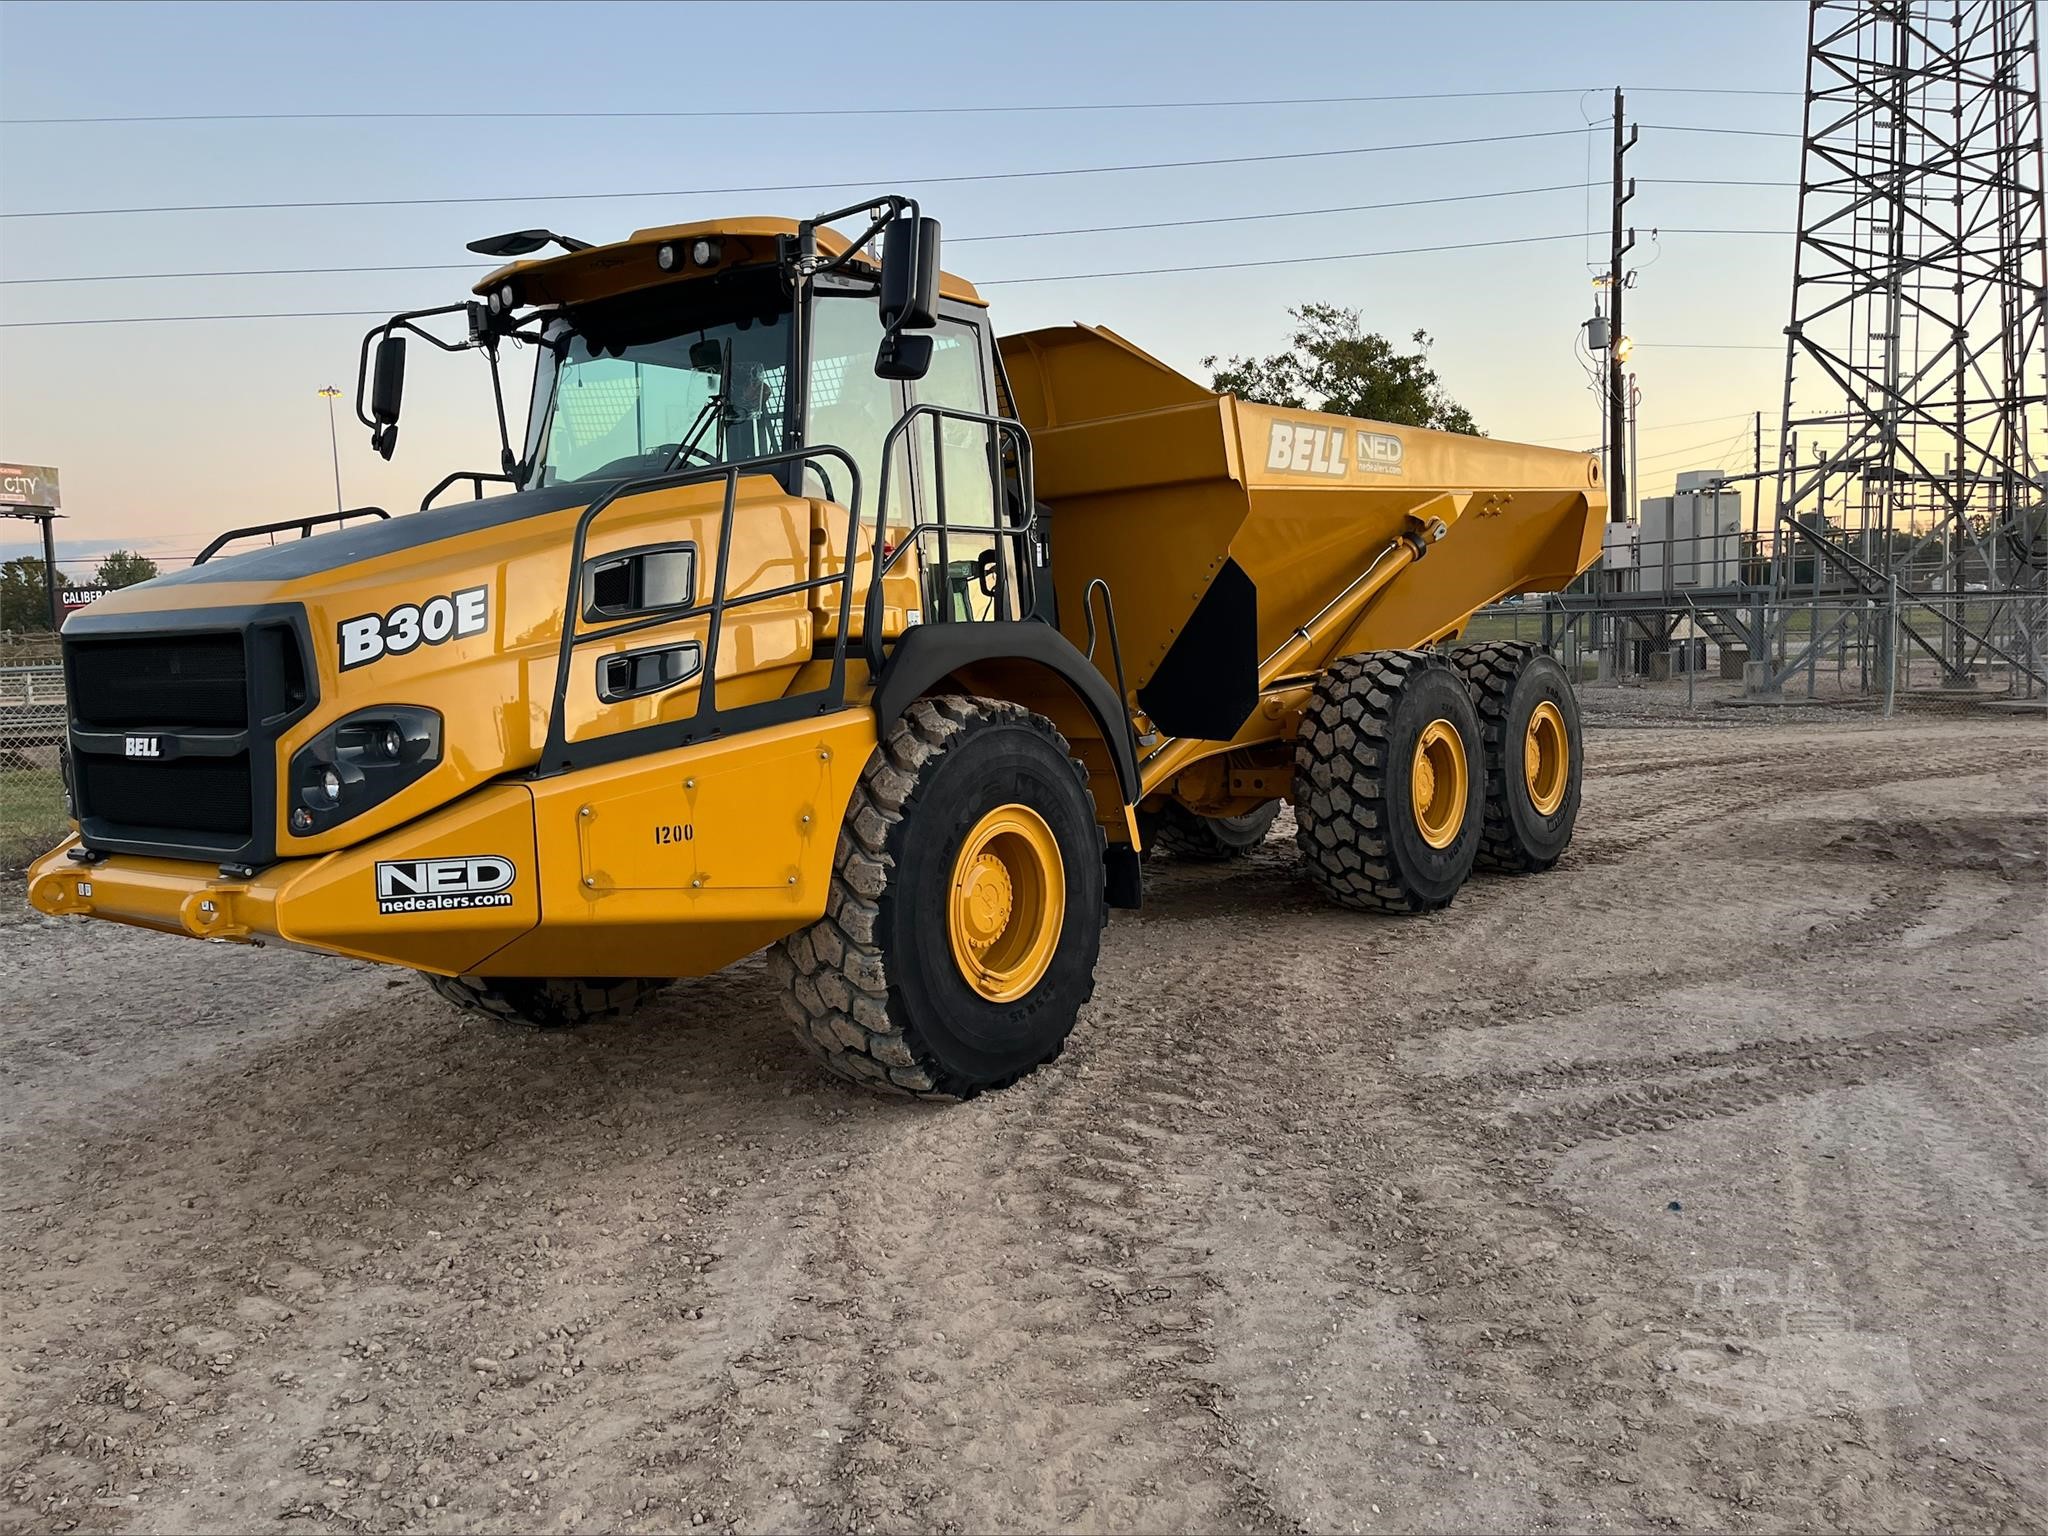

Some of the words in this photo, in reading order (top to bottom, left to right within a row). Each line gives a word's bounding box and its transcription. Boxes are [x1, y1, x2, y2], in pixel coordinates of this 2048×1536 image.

[1267, 423, 1346, 475] BELL
[1358, 433, 1402, 461] NED
[1358, 462, 1402, 475] nedealers.com
[4, 476, 40, 495] CITY
[341, 588, 486, 667] B30E
[126, 737, 160, 757] BELL
[656, 824, 693, 845] 1200
[379, 858, 513, 895] NED
[381, 894, 511, 913] nedealers.com
